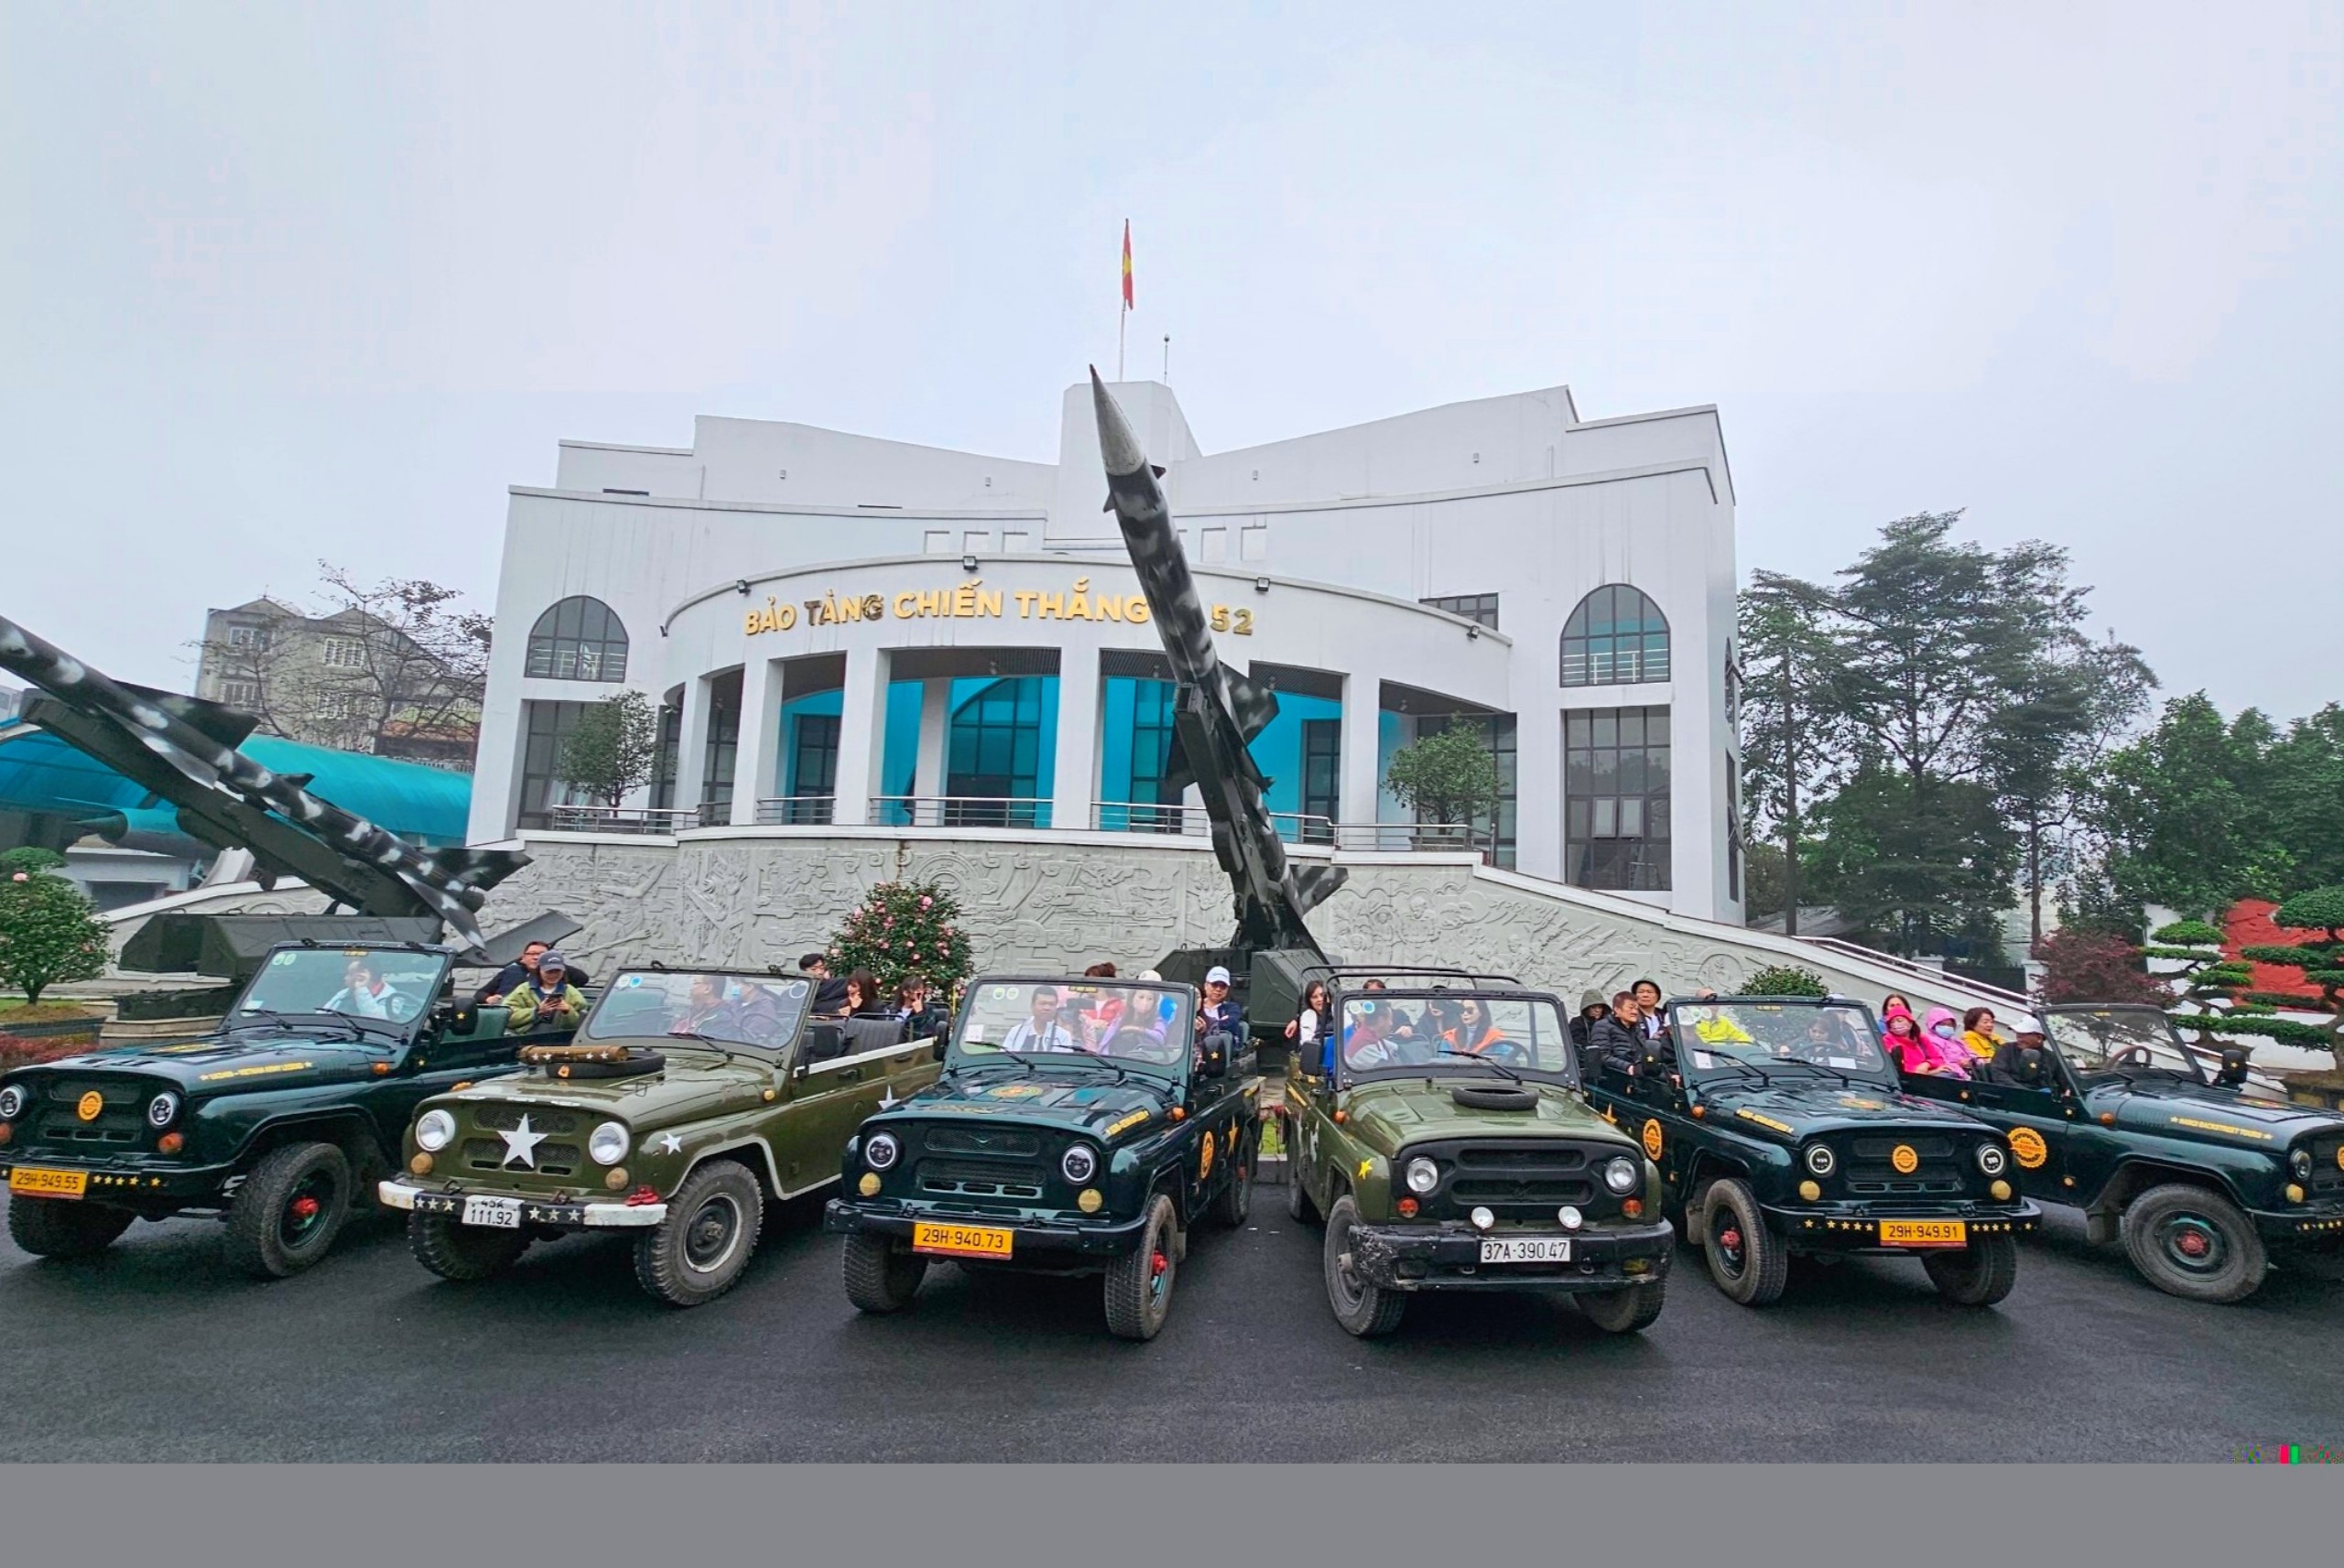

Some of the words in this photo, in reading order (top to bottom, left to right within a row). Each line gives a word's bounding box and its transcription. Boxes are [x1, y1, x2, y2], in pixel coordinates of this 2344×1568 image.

[745, 596, 797, 635] BẢO
[804, 589, 884, 626] TÀNG
[892, 578, 1004, 620] CHIẾN
[1015, 576, 1150, 624] THẮNG
[16, 1172, 80, 1189] 29H-949.55
[471, 1209, 513, 1225] 111.92
[922, 1227, 1004, 1249] 29H-940.73
[1888, 1225, 1958, 1238] 29H-949.91
[1483, 1242, 1567, 1260] 37A-390.47
